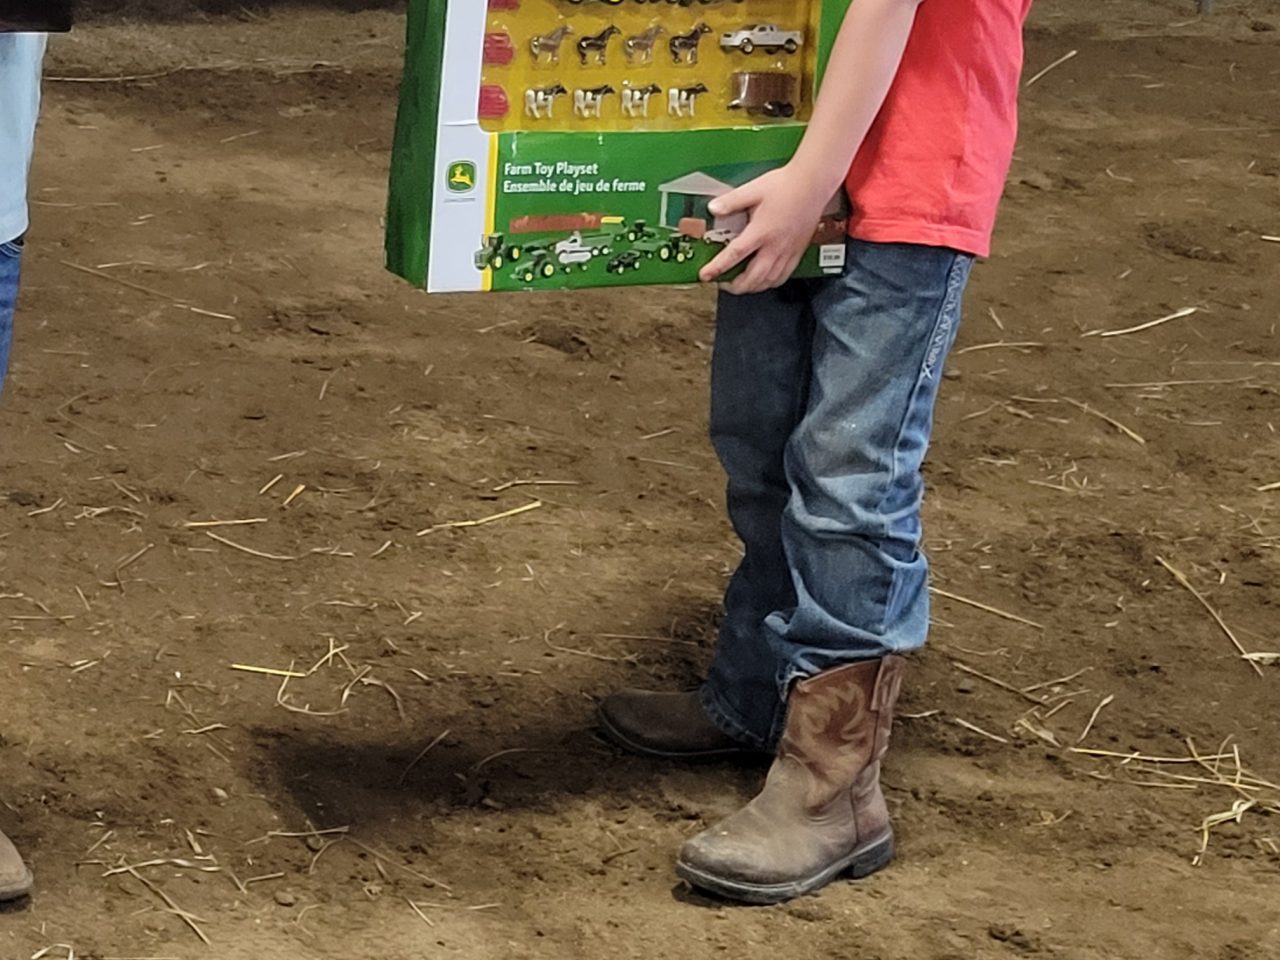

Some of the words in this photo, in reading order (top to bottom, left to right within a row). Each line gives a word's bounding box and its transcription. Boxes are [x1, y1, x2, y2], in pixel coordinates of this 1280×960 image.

[504, 163, 532, 175] Farm
[534, 163, 554, 178] Toy
[556, 161, 598, 178] Playset
[503, 180, 558, 192] Ensemble
[559, 180, 573, 192] de
[574, 181, 596, 195] jeu
[597, 180, 610, 192] de
[612, 179, 646, 192] ferme
